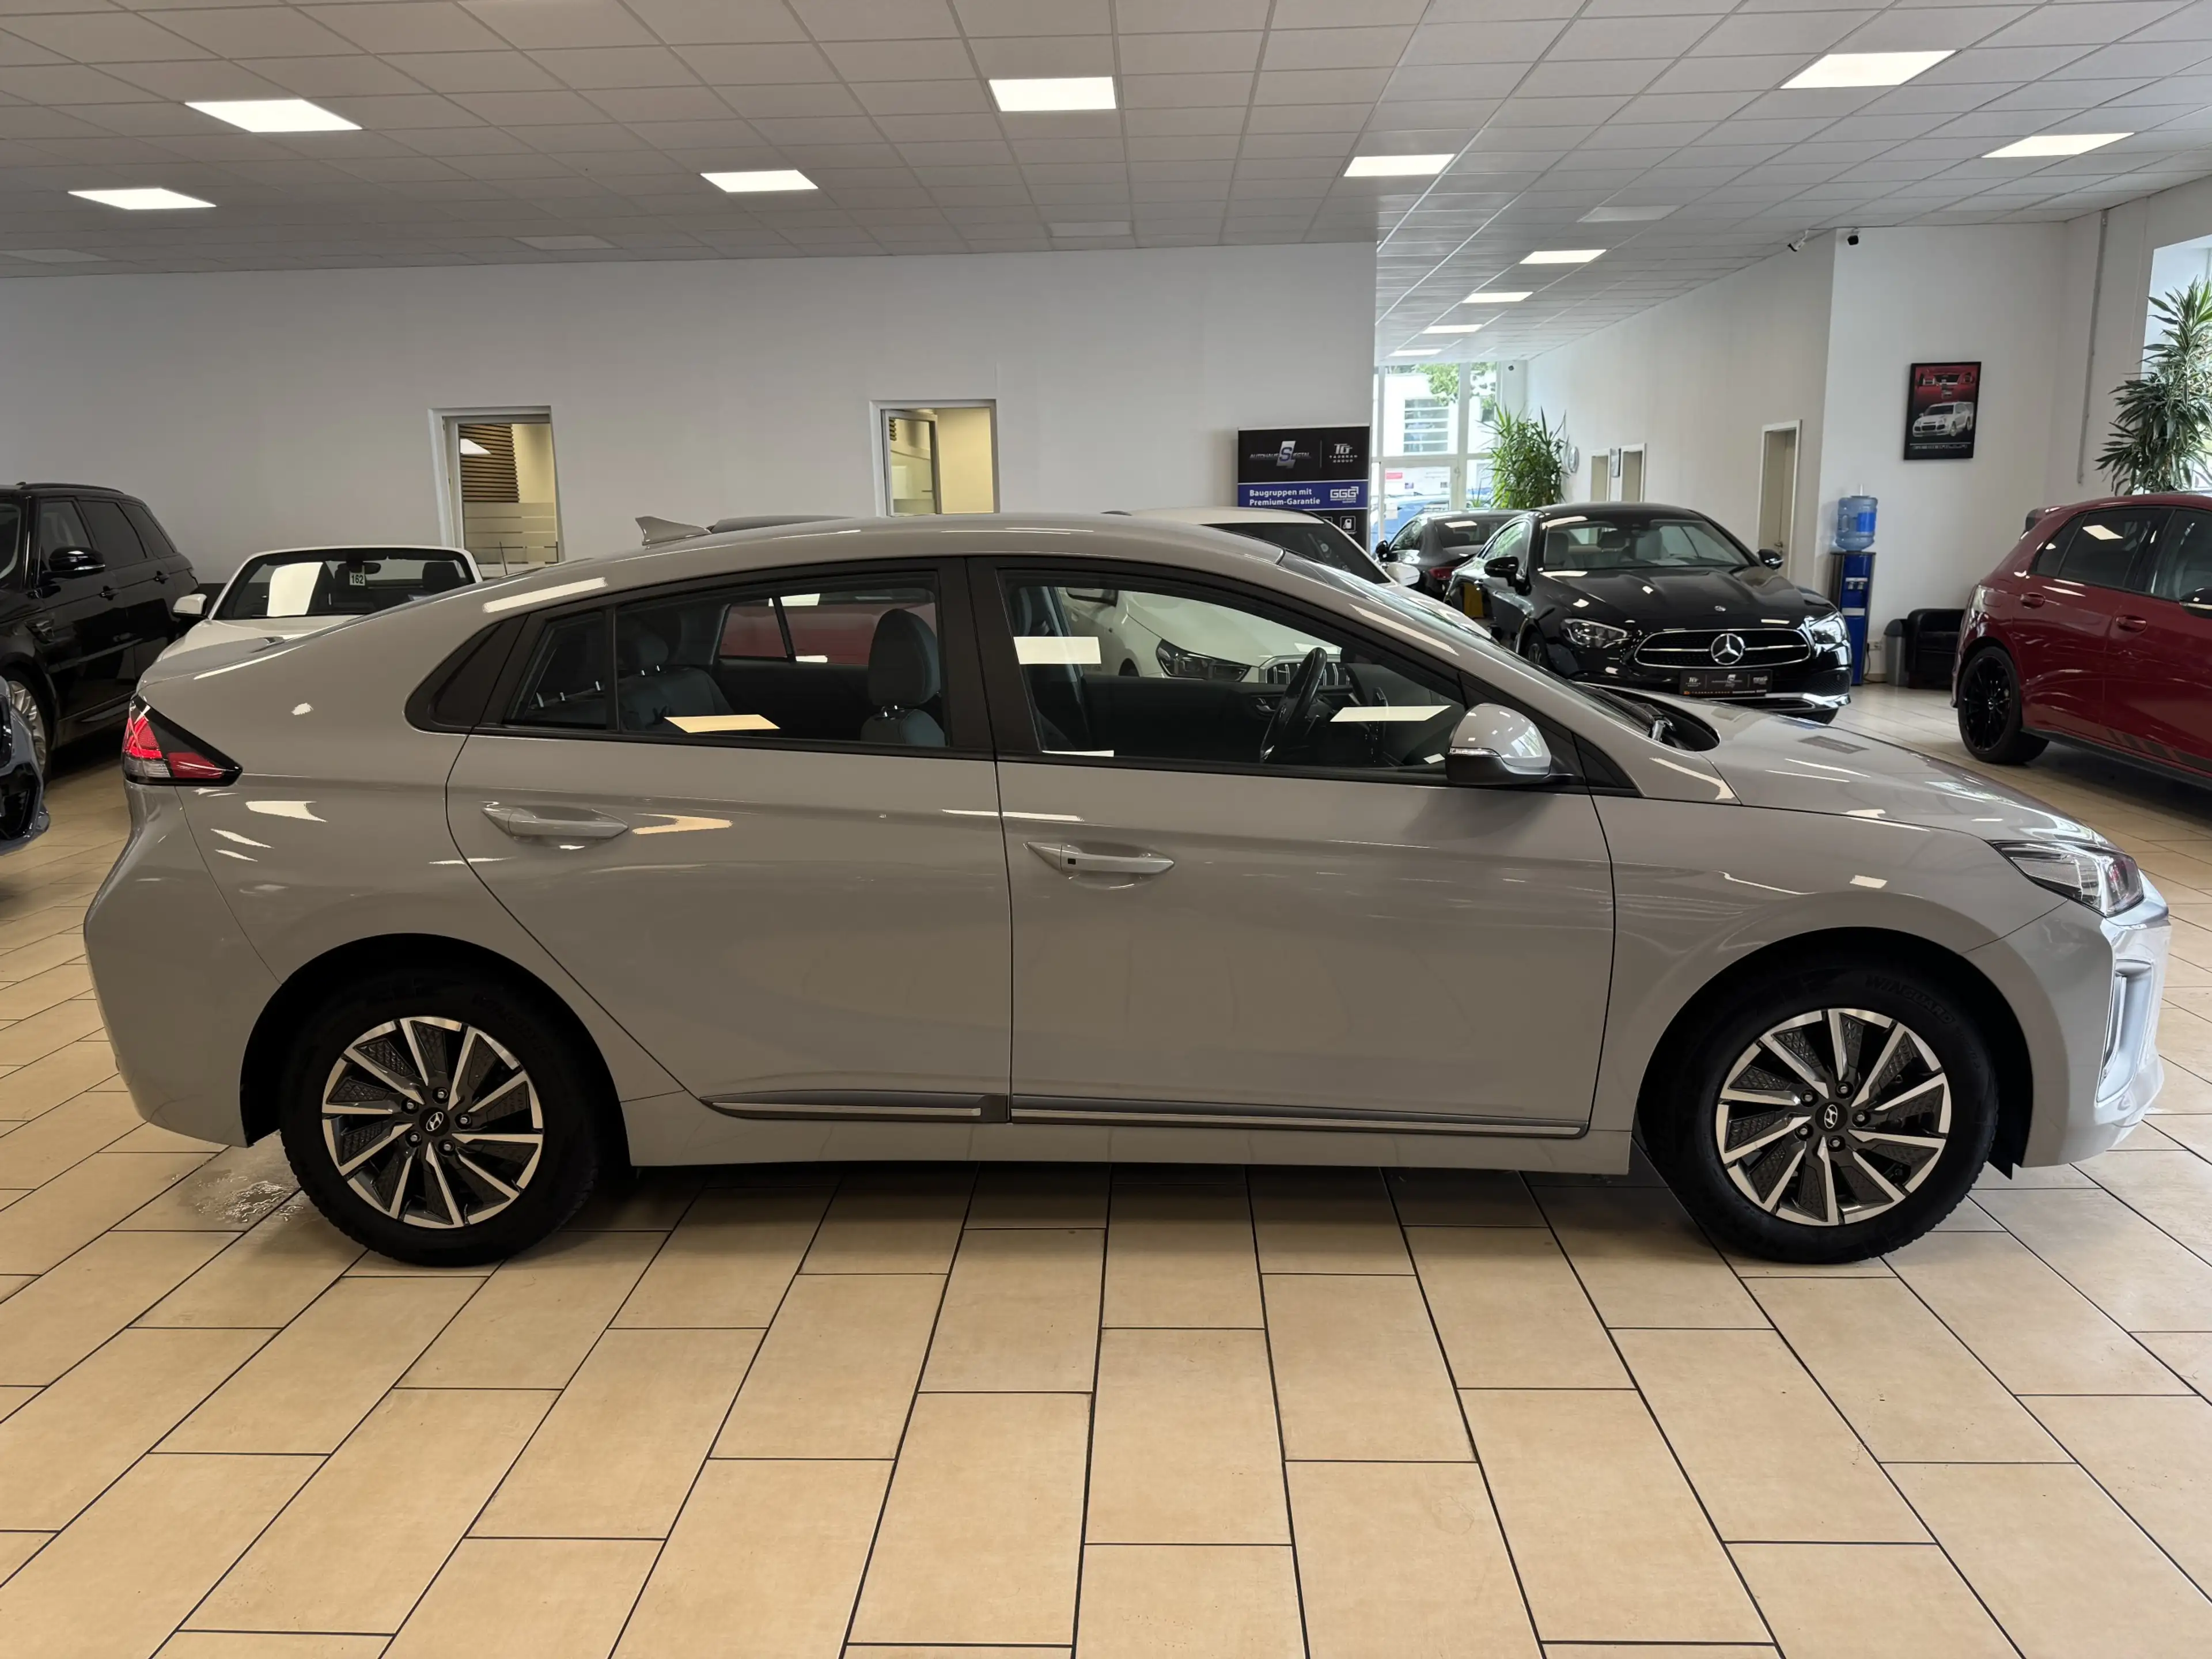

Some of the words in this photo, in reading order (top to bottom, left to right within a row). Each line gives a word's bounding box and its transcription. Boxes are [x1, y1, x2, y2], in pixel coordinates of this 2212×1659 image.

[1330, 488, 1357, 498] GGG
[1249, 497, 1320, 506] Premium-Garantie
[351, 574, 363, 584] 162
